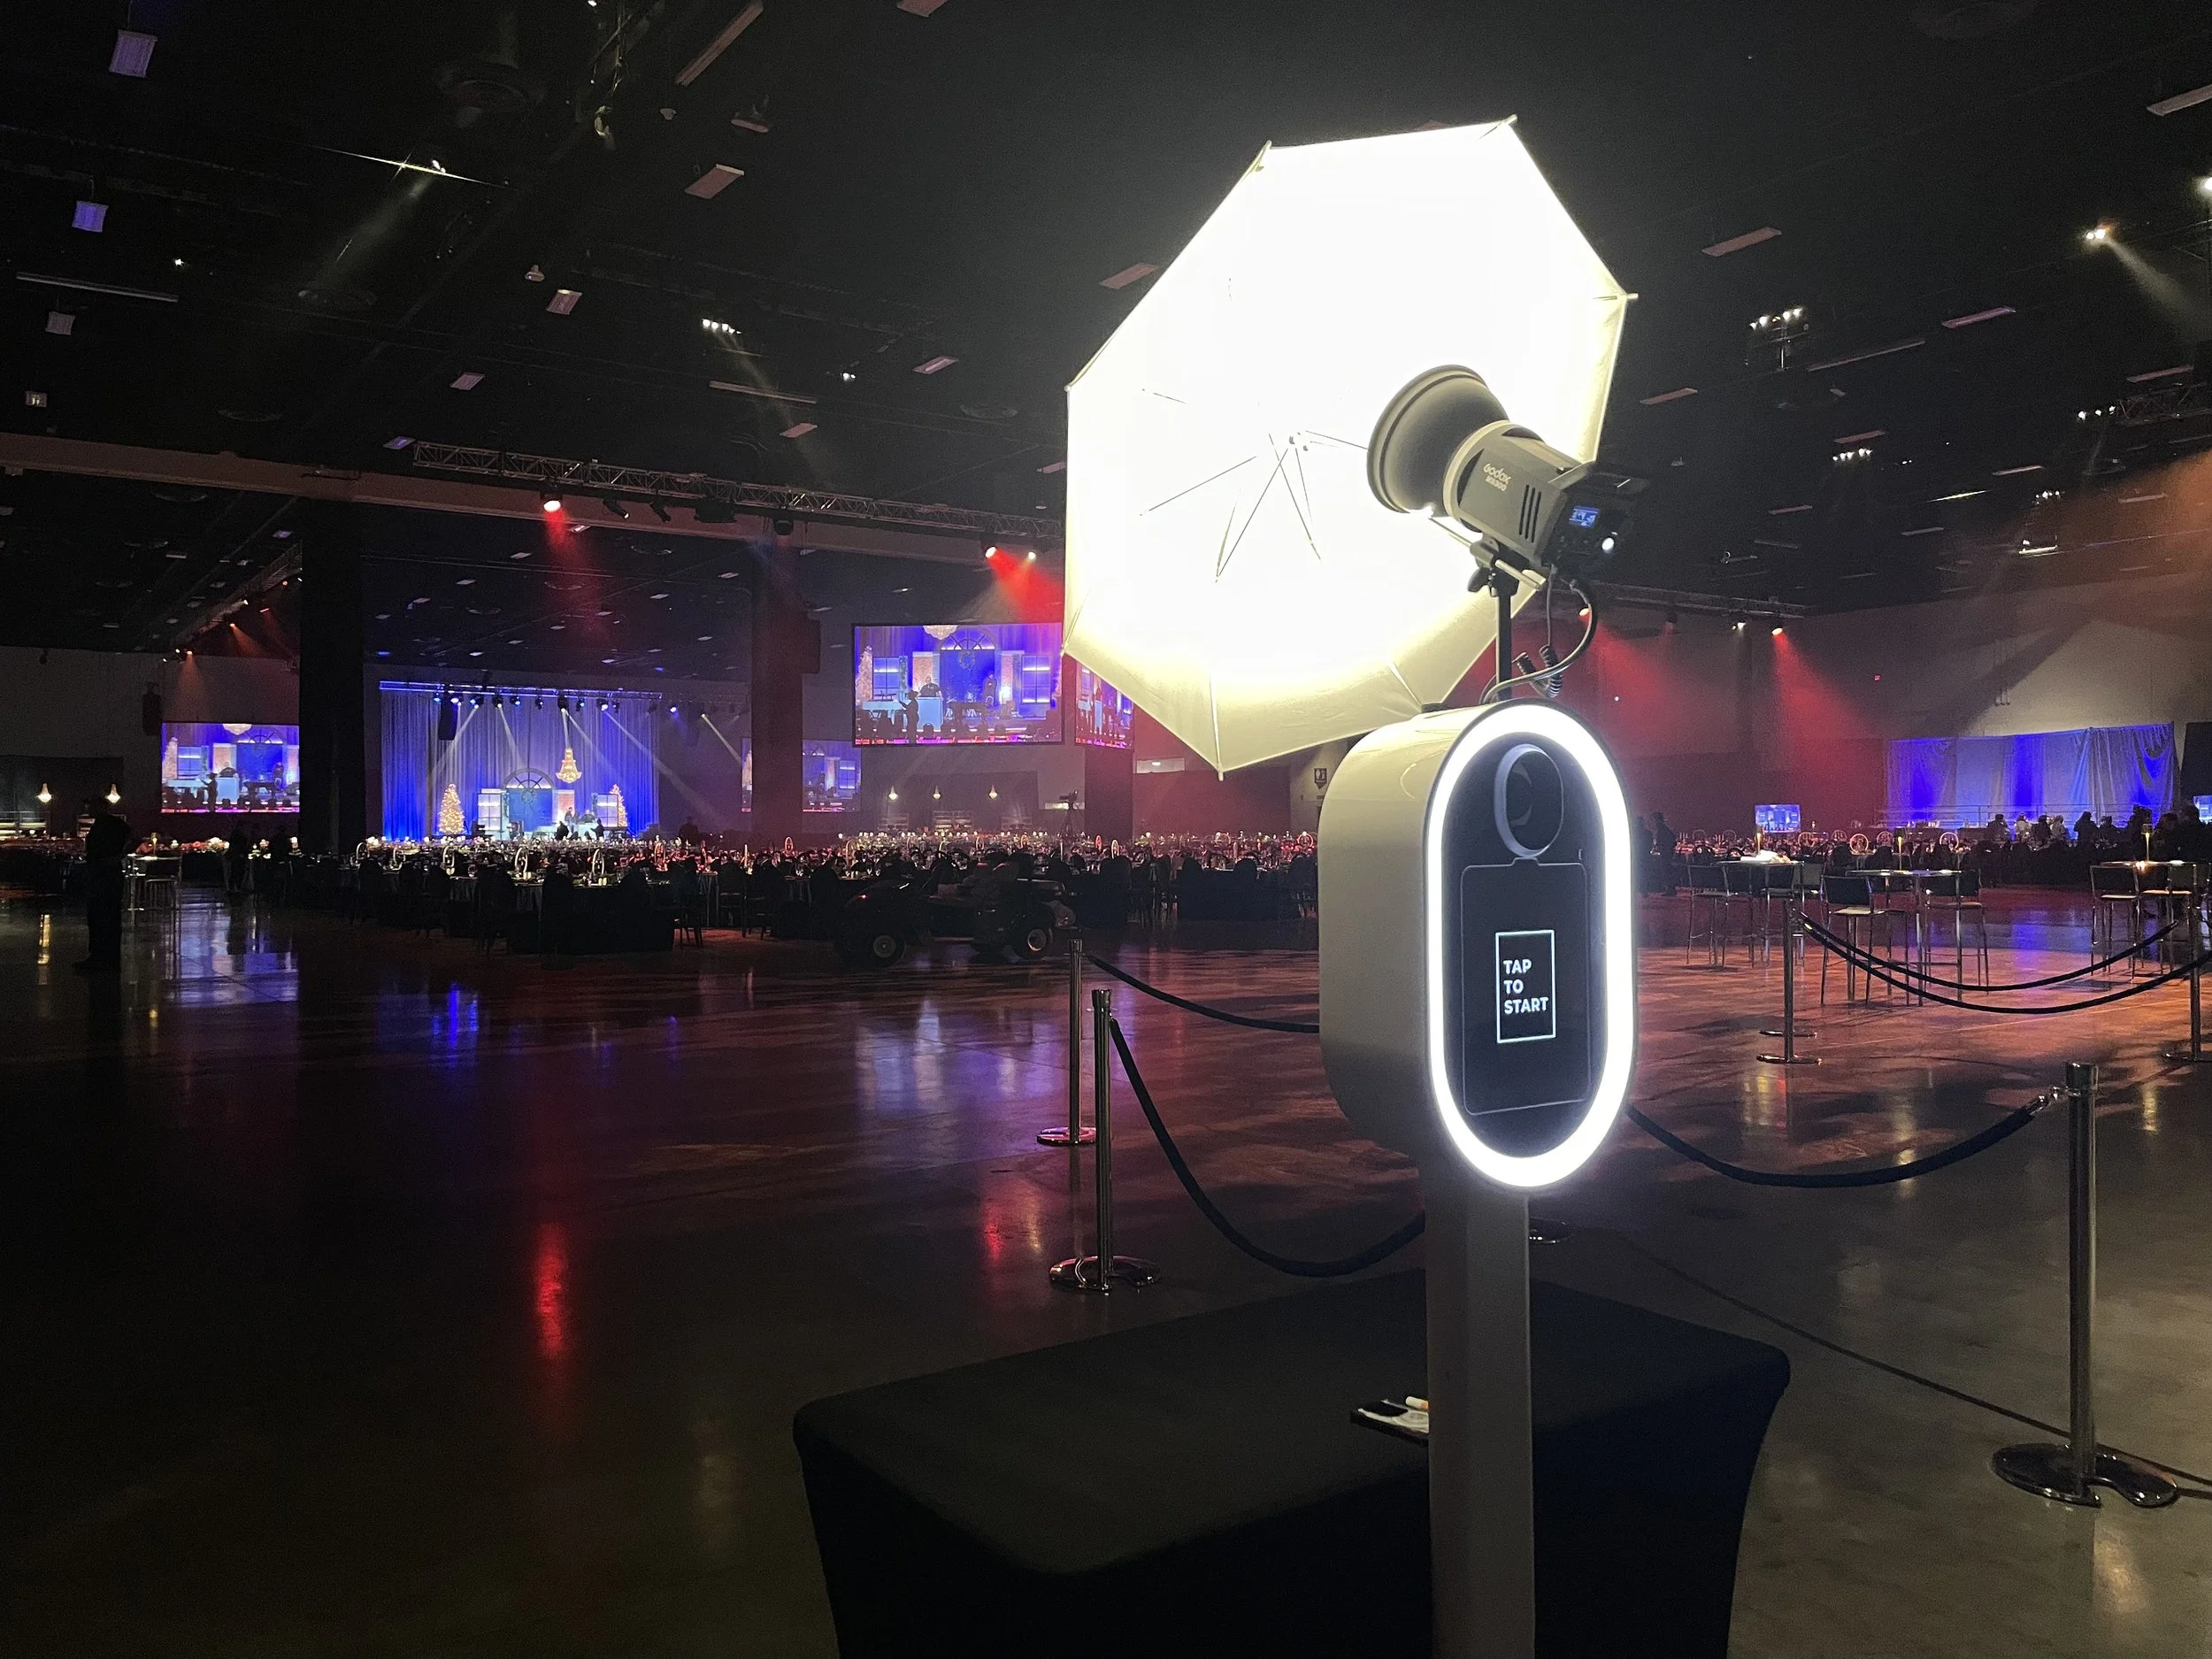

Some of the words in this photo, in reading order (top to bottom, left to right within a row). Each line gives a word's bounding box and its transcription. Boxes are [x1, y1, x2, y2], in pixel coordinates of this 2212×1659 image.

[1484, 464, 1511, 484] Godox
[1503, 959, 1532, 974] TAP
[1503, 979, 1524, 995] TO
[1504, 997, 1548, 1014] START
